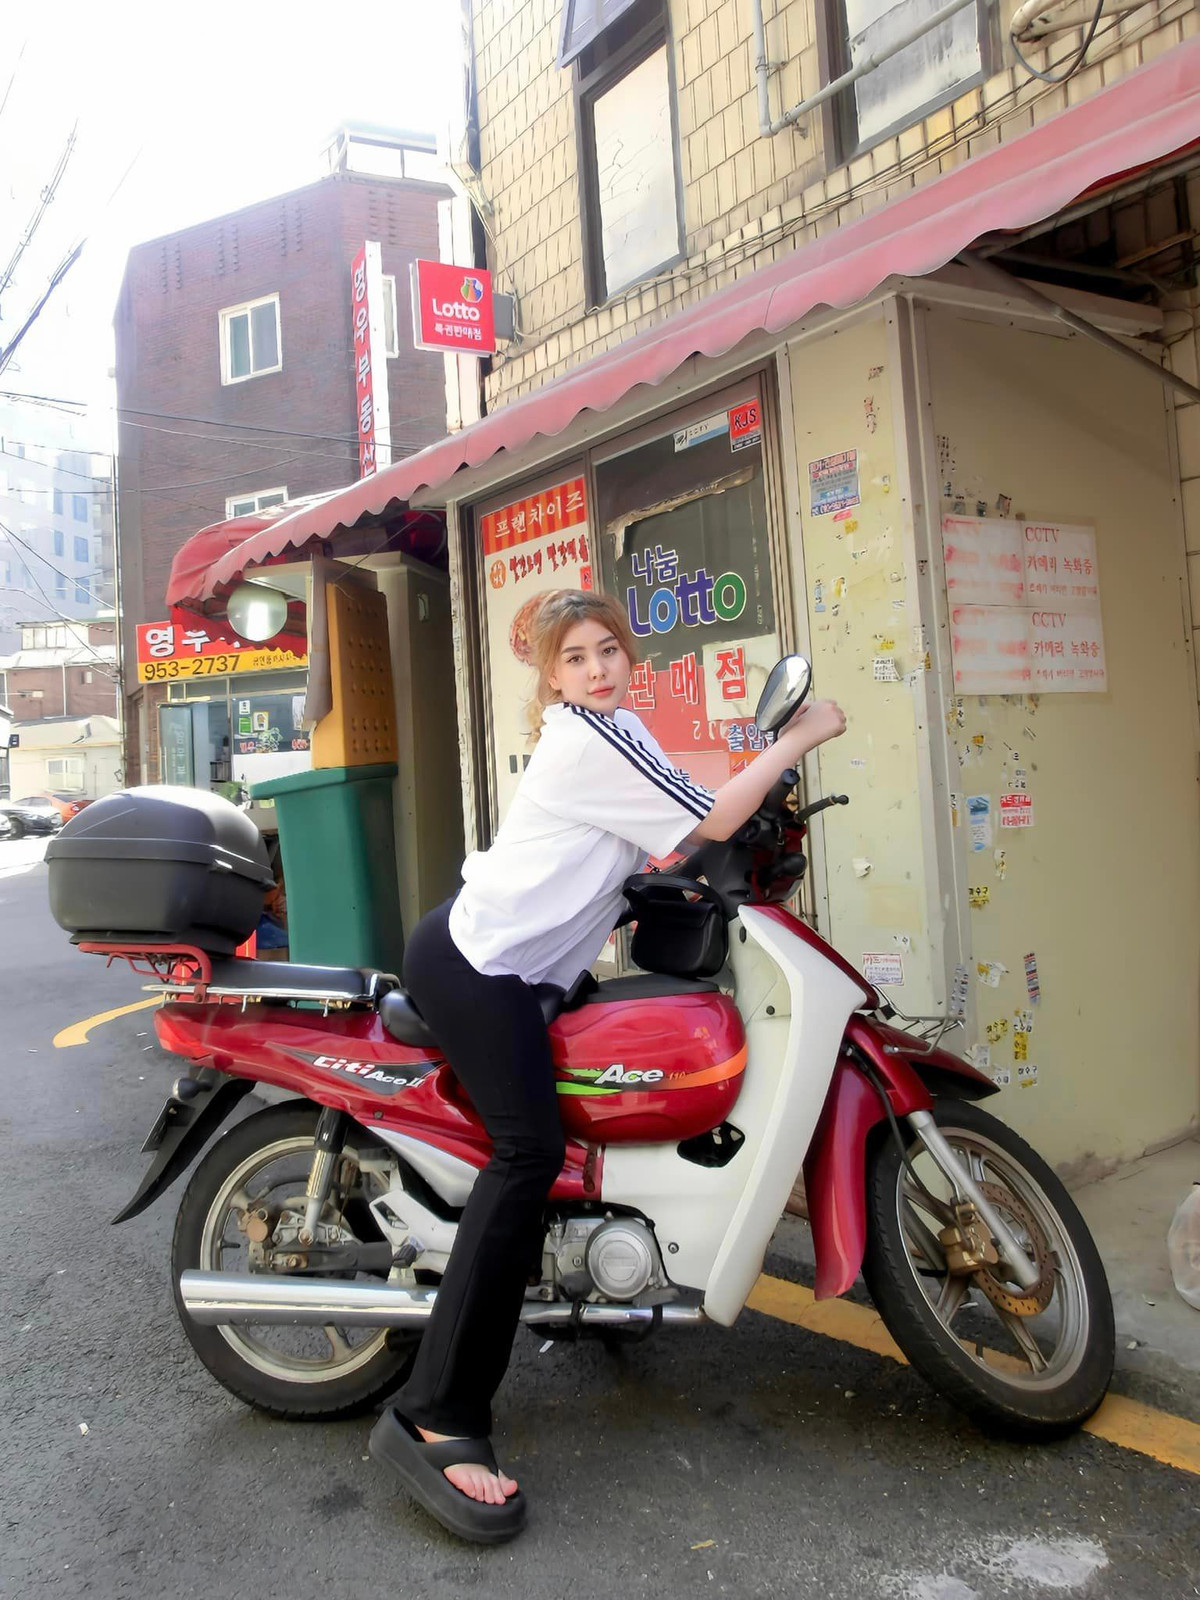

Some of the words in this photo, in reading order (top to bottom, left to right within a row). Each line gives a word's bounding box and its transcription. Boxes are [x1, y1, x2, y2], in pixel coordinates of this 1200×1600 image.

[432, 298, 481, 321] Lotto
[434, 322, 482, 341] 복권판매점
[1025, 526, 1060, 542] CCTV
[632, 545, 678, 586] 나눔
[627, 568, 747, 638] Lotto
[1032, 612, 1066, 628] CCTV
[144, 654, 241, 681] 953-2737
[593, 1063, 664, 1085] Ace
